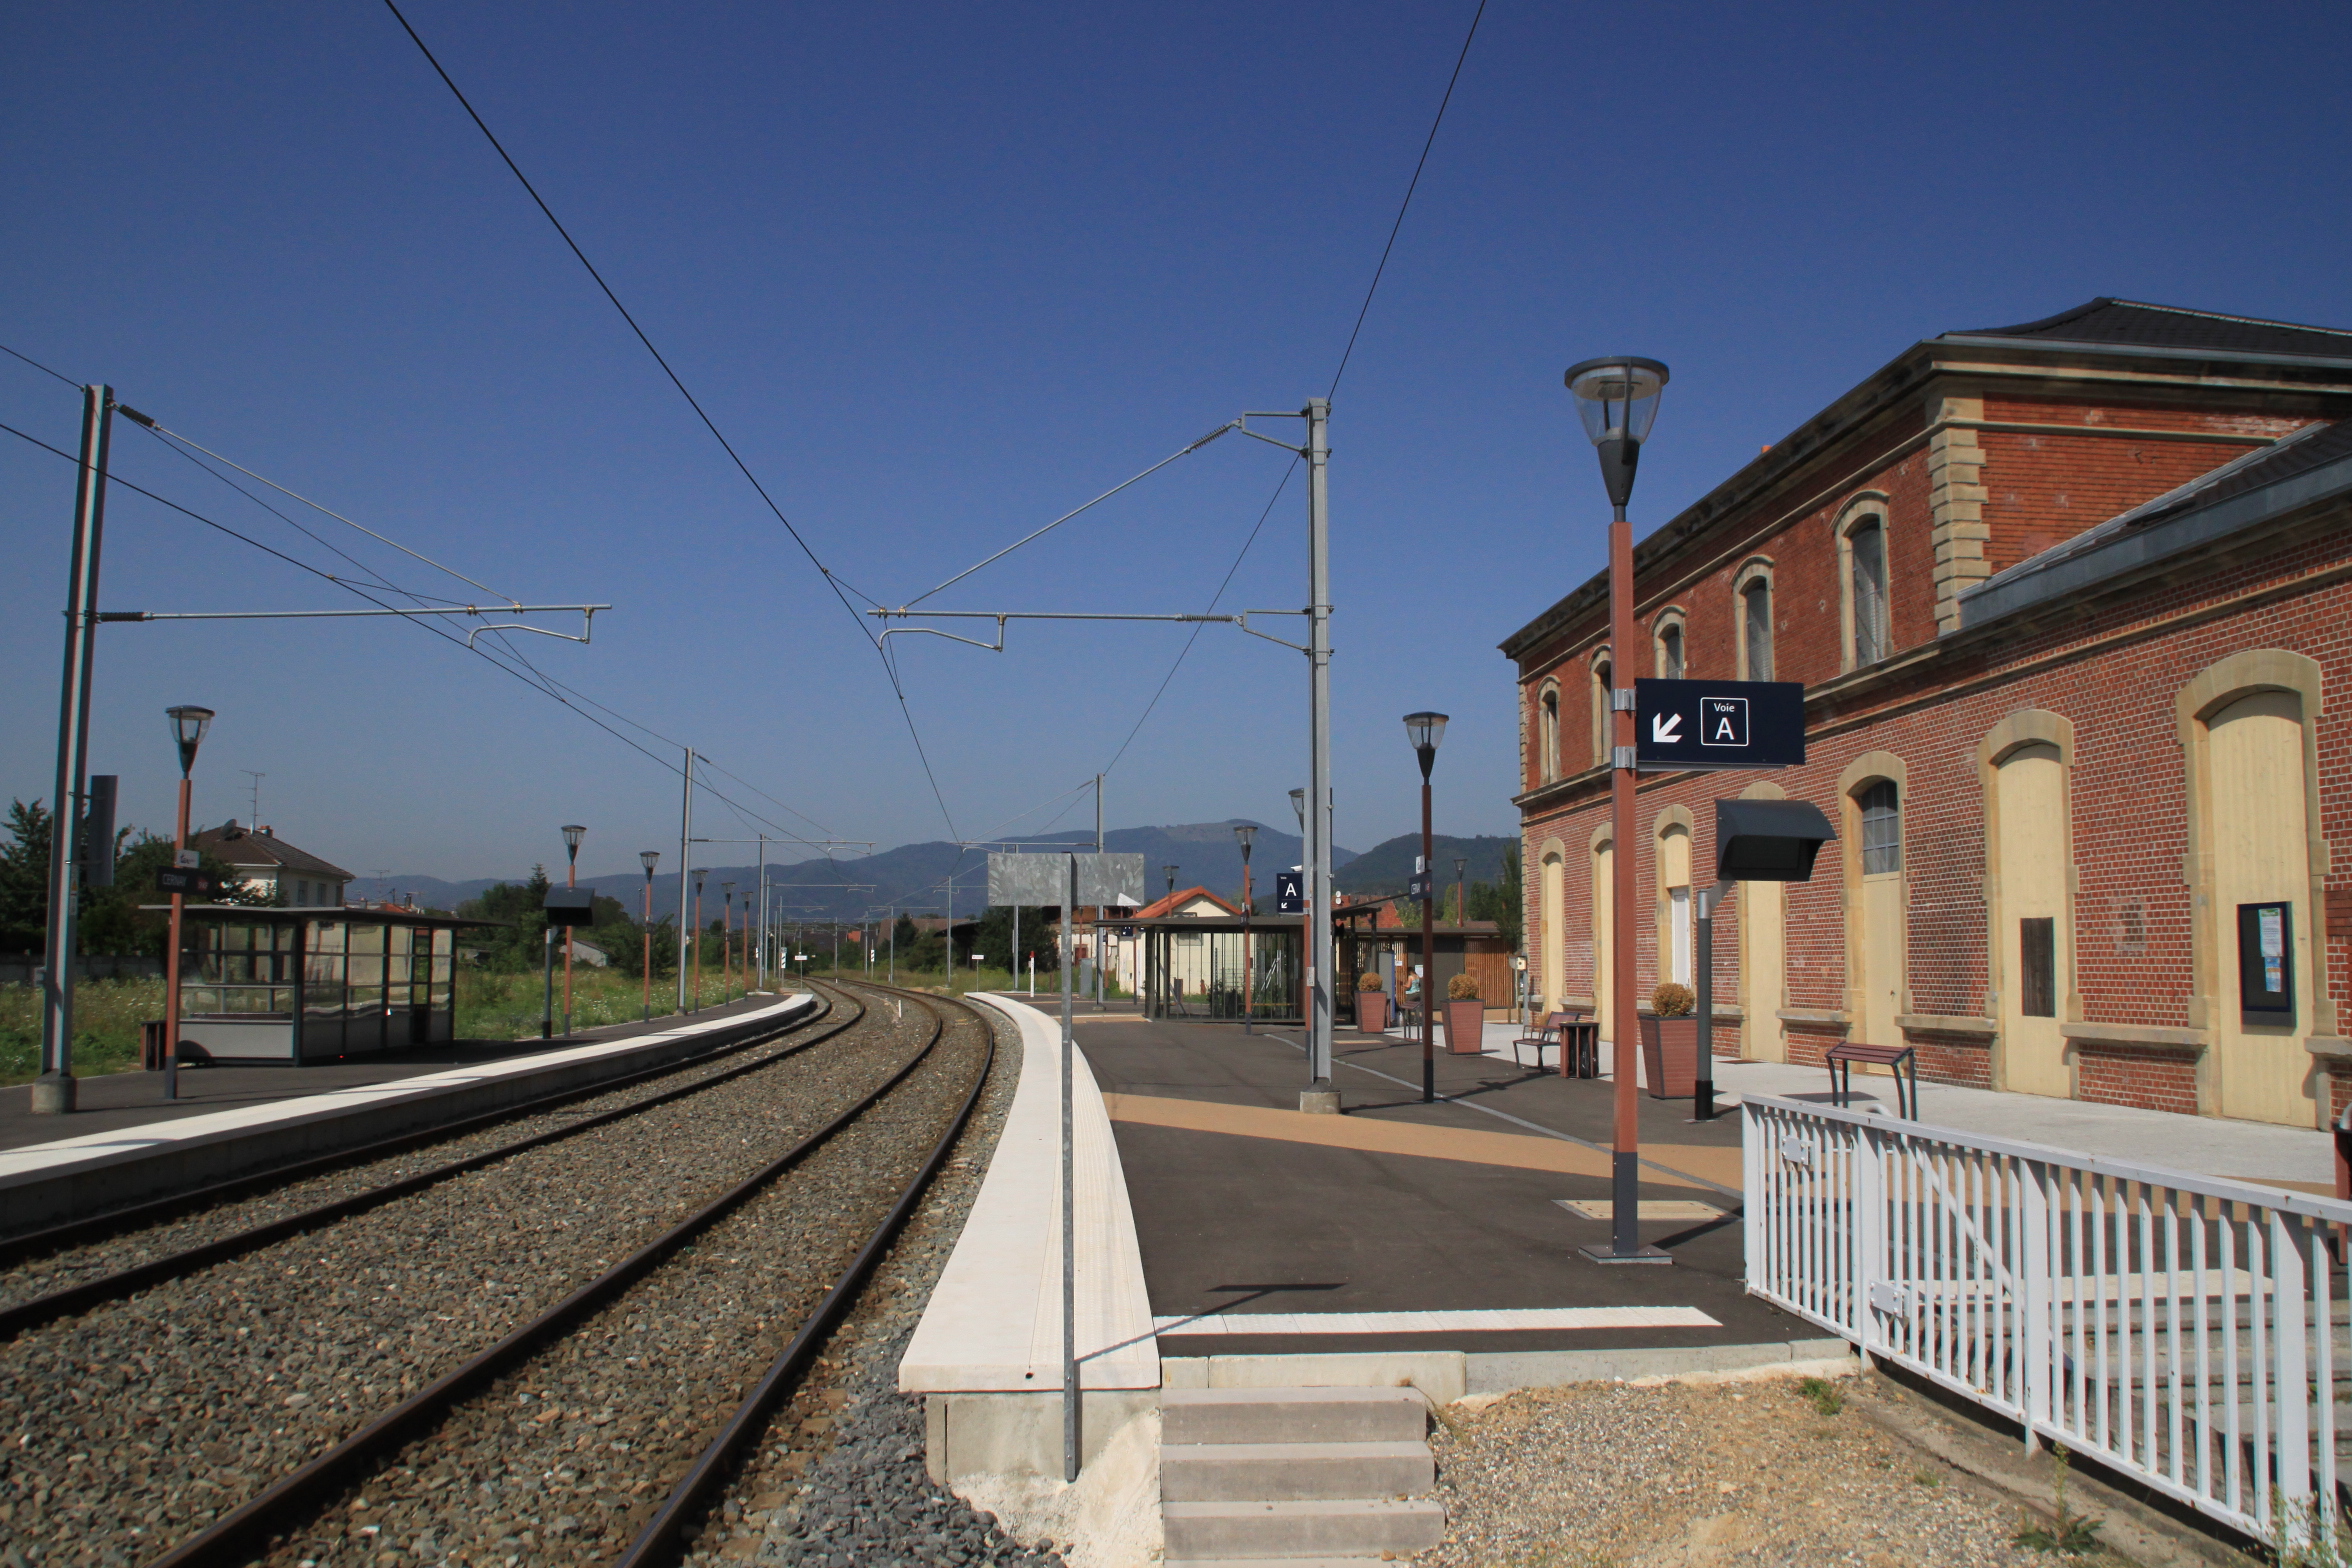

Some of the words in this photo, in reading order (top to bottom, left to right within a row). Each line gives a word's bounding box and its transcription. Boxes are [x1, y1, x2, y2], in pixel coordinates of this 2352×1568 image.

[1714, 703, 1735, 712] Voie
[1715, 717, 1735, 740] A
[1285, 883, 1297, 896] A
